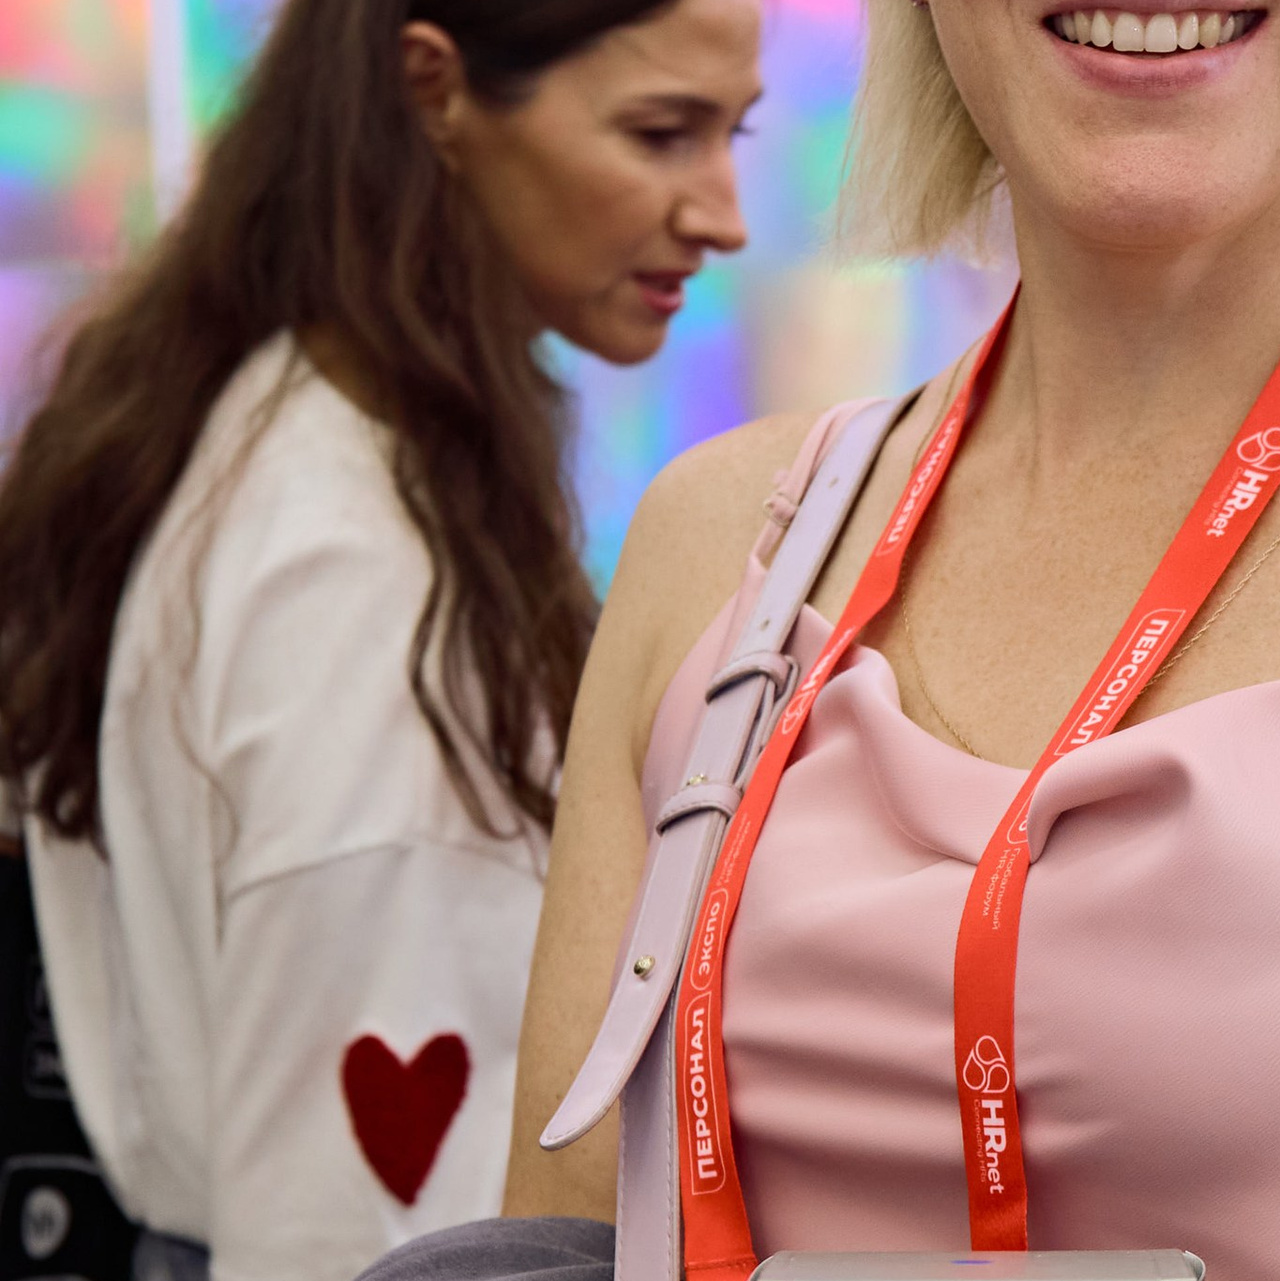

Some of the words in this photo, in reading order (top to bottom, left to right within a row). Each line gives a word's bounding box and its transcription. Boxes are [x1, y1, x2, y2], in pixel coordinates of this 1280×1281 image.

[1206, 469, 1269, 537] HRnet
[1070, 618, 1169, 745] ПЕРСОНАЛ
[991, 848, 1021, 930] Глобальный
[698, 900, 721, 976] ЭКСПО
[690, 1007, 717, 1179] ПЕРСОНАЛ
[982, 1099, 1007, 1194] HRnet
